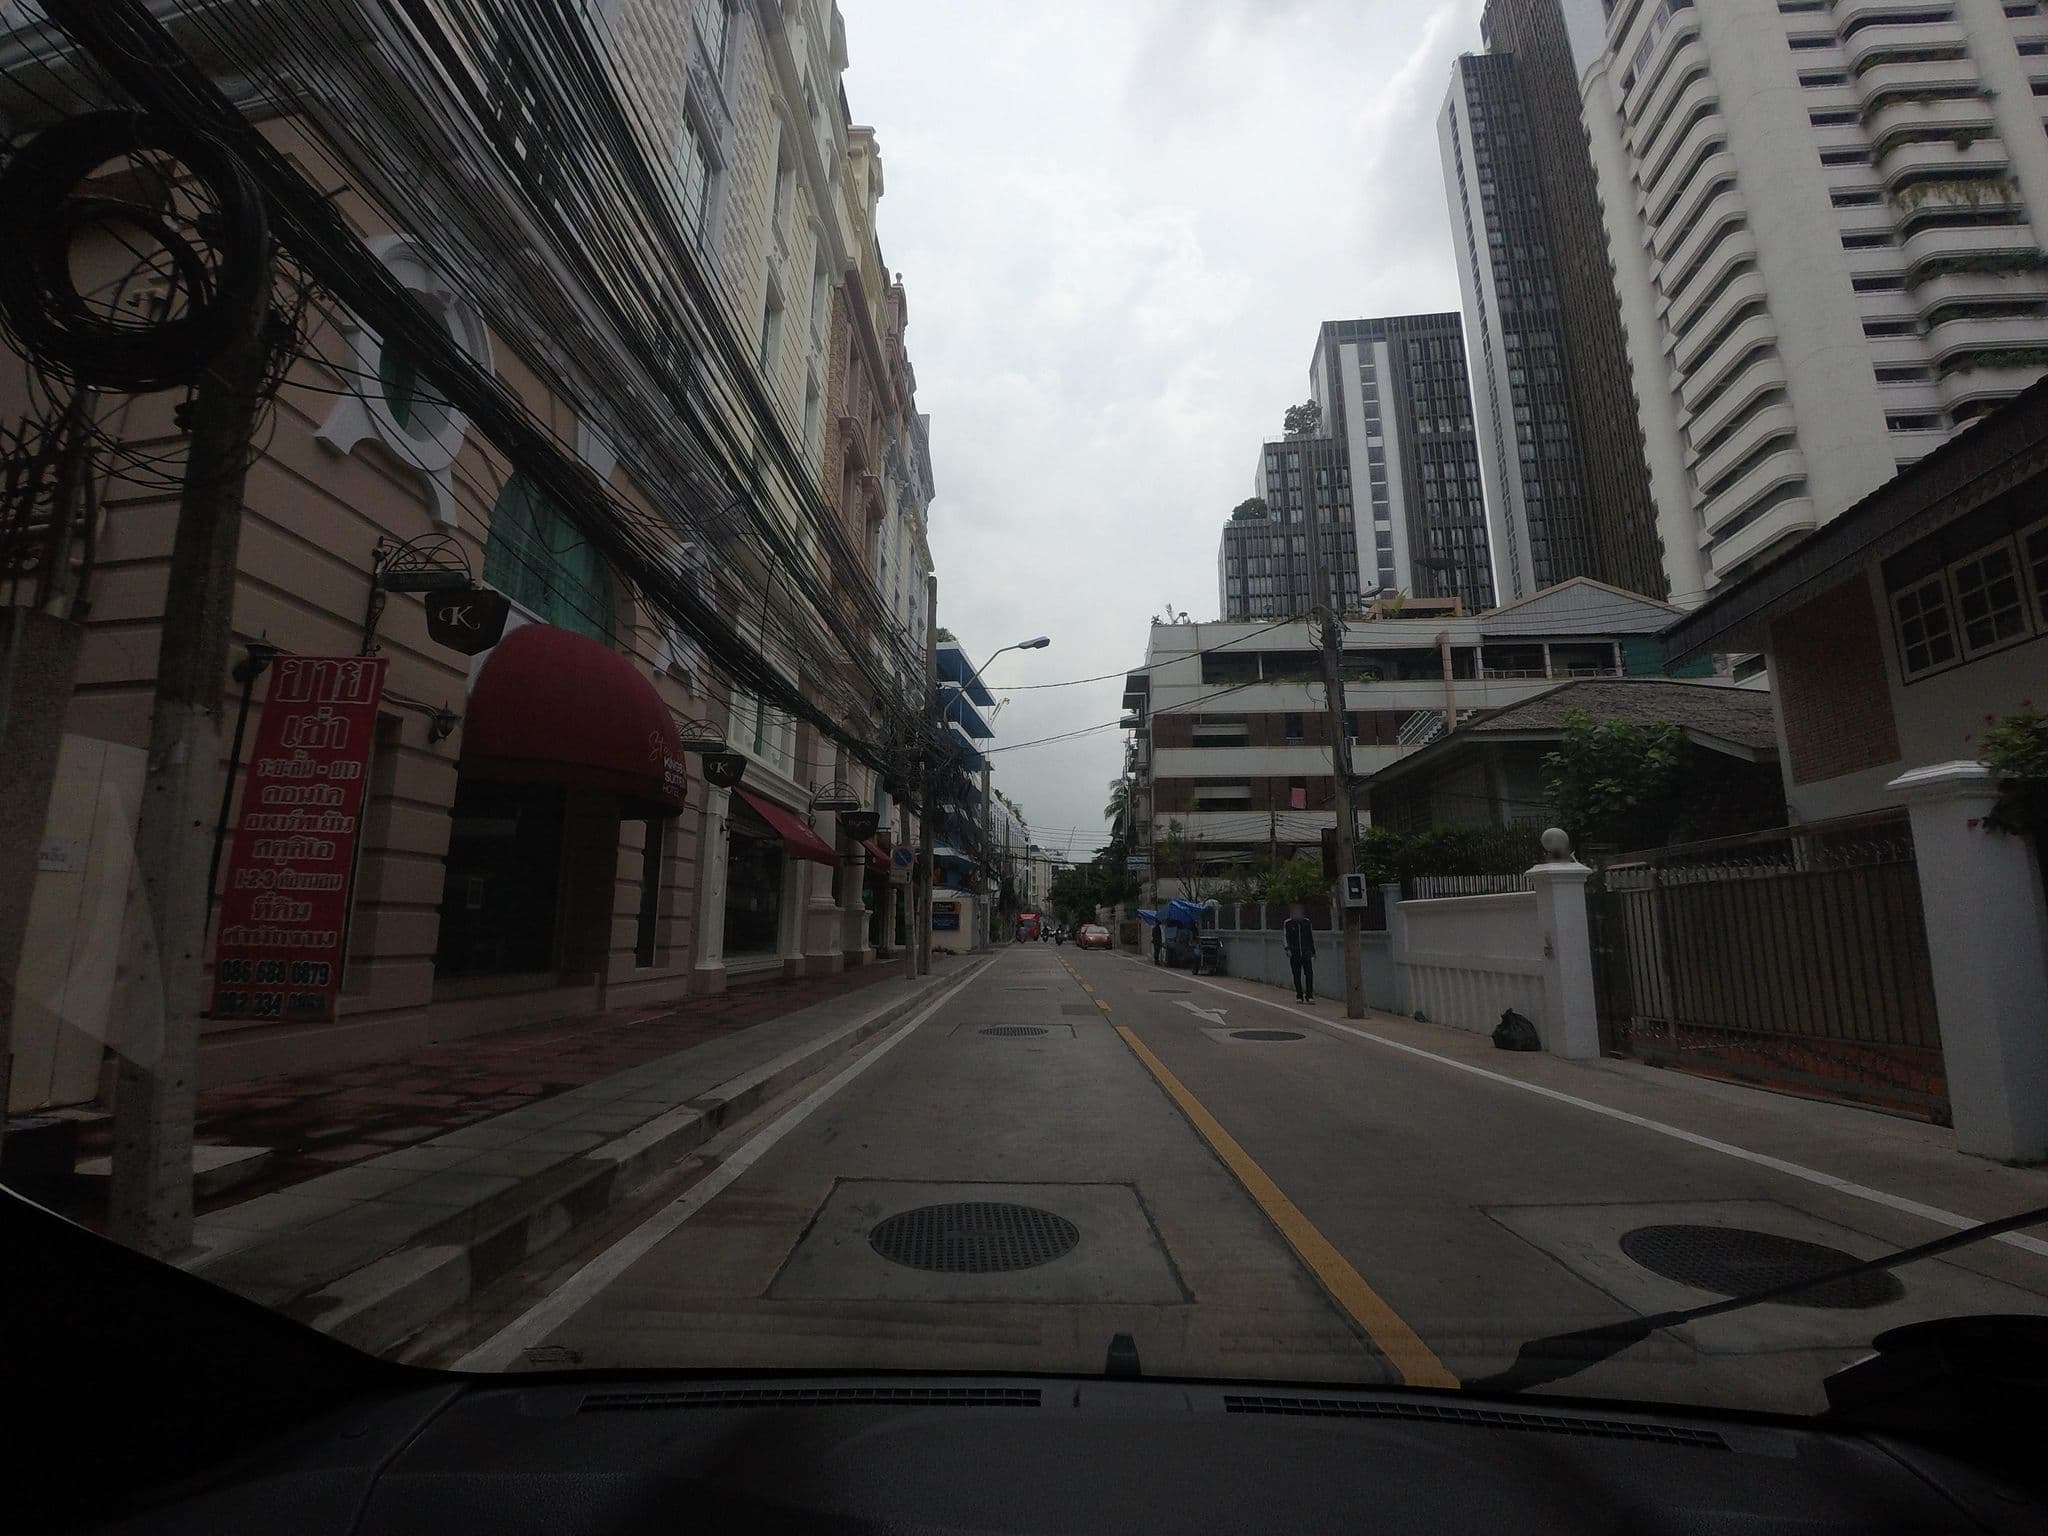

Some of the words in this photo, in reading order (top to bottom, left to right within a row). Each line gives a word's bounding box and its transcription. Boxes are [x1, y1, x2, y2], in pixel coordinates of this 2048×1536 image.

[439, 605, 480, 630] K
[275, 660, 378, 704] ขาย
[281, 706, 351, 749] เช่า
[262, 784, 345, 806] คอนโด
[250, 891, 313, 922] ที่ดิน
[223, 924, 337, 948] สำนักงาน
